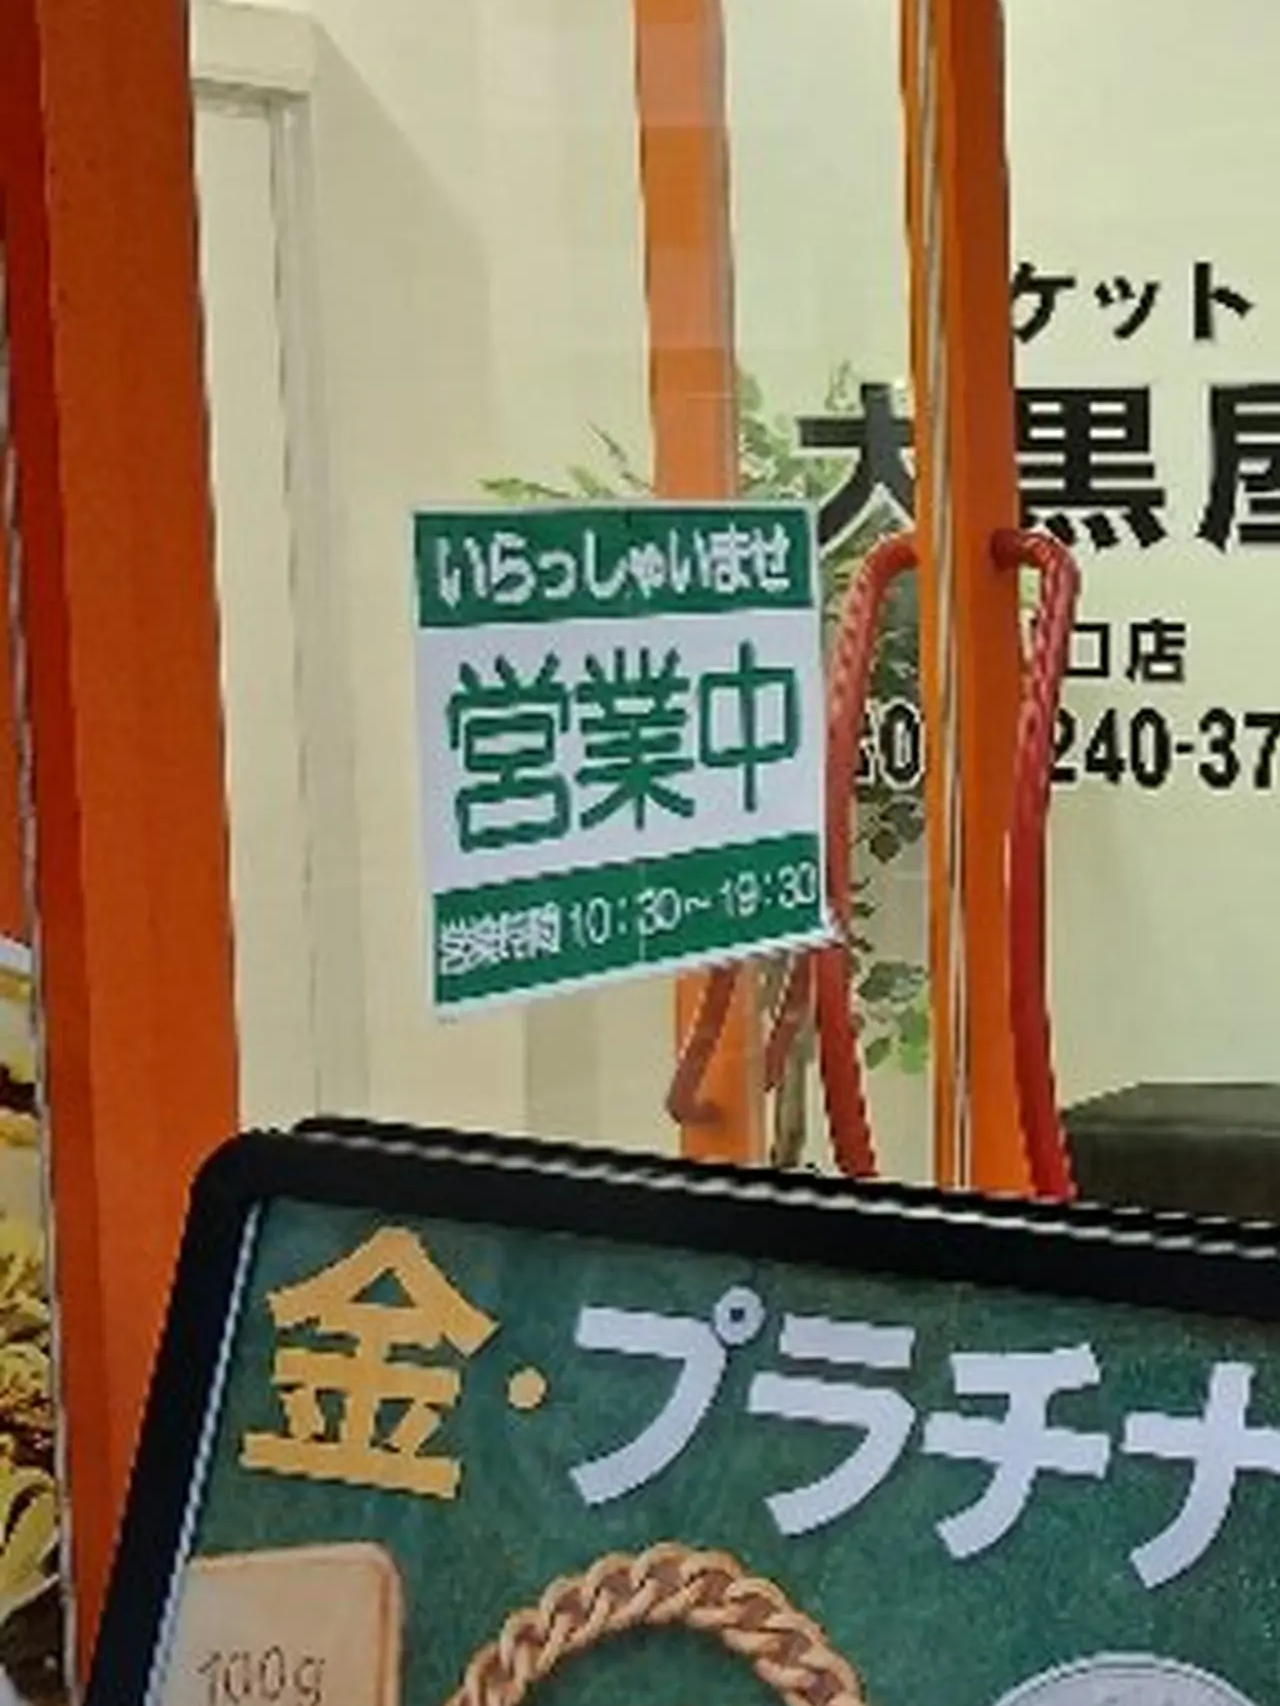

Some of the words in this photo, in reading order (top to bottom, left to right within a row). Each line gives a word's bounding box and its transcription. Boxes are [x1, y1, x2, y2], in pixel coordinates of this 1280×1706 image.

[1010, 262, 1256, 345] ケット
[434, 522, 793, 607] いらっしゃいませ
[1062, 618, 1188, 684] 口店
[446, 638, 799, 853] 営業中
